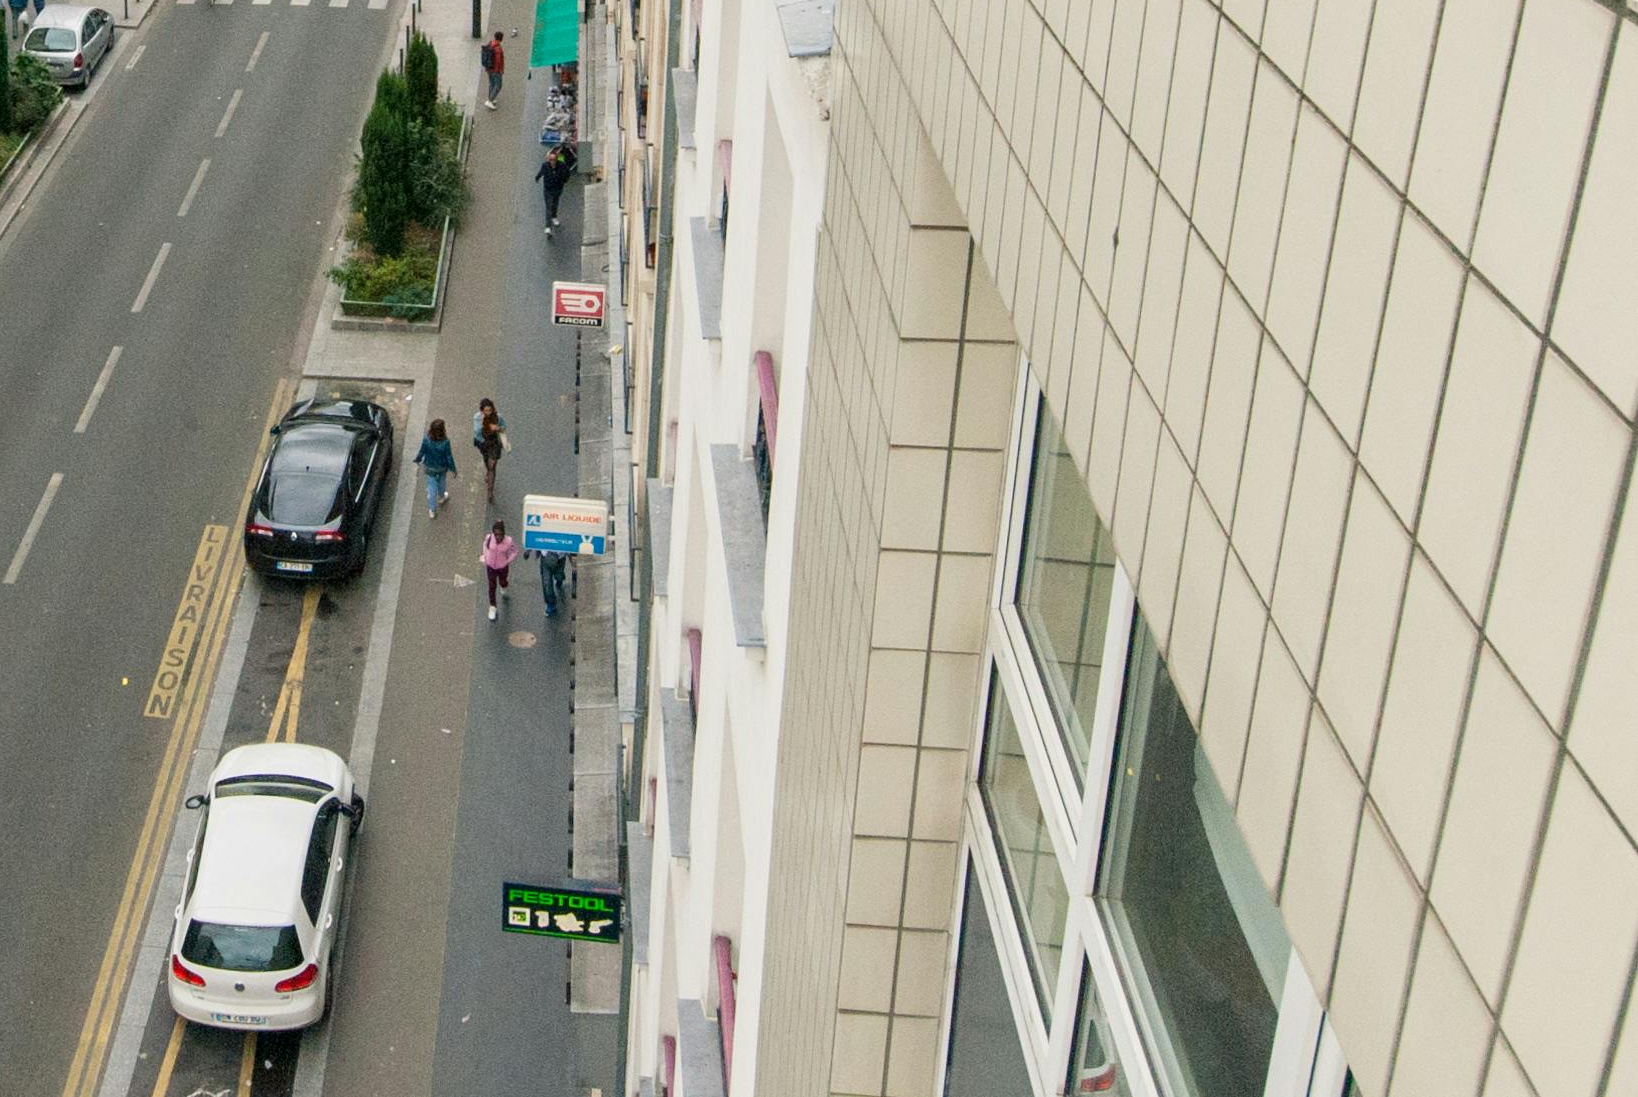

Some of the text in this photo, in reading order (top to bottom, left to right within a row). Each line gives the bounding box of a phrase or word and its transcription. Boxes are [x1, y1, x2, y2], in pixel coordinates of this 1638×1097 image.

[558, 316, 599, 326] FACOM
[542, 512, 603, 524] AIR LIQUIDE
[148, 526, 220, 717] LIVRAISON
[508, 888, 614, 913] FESTOOL
